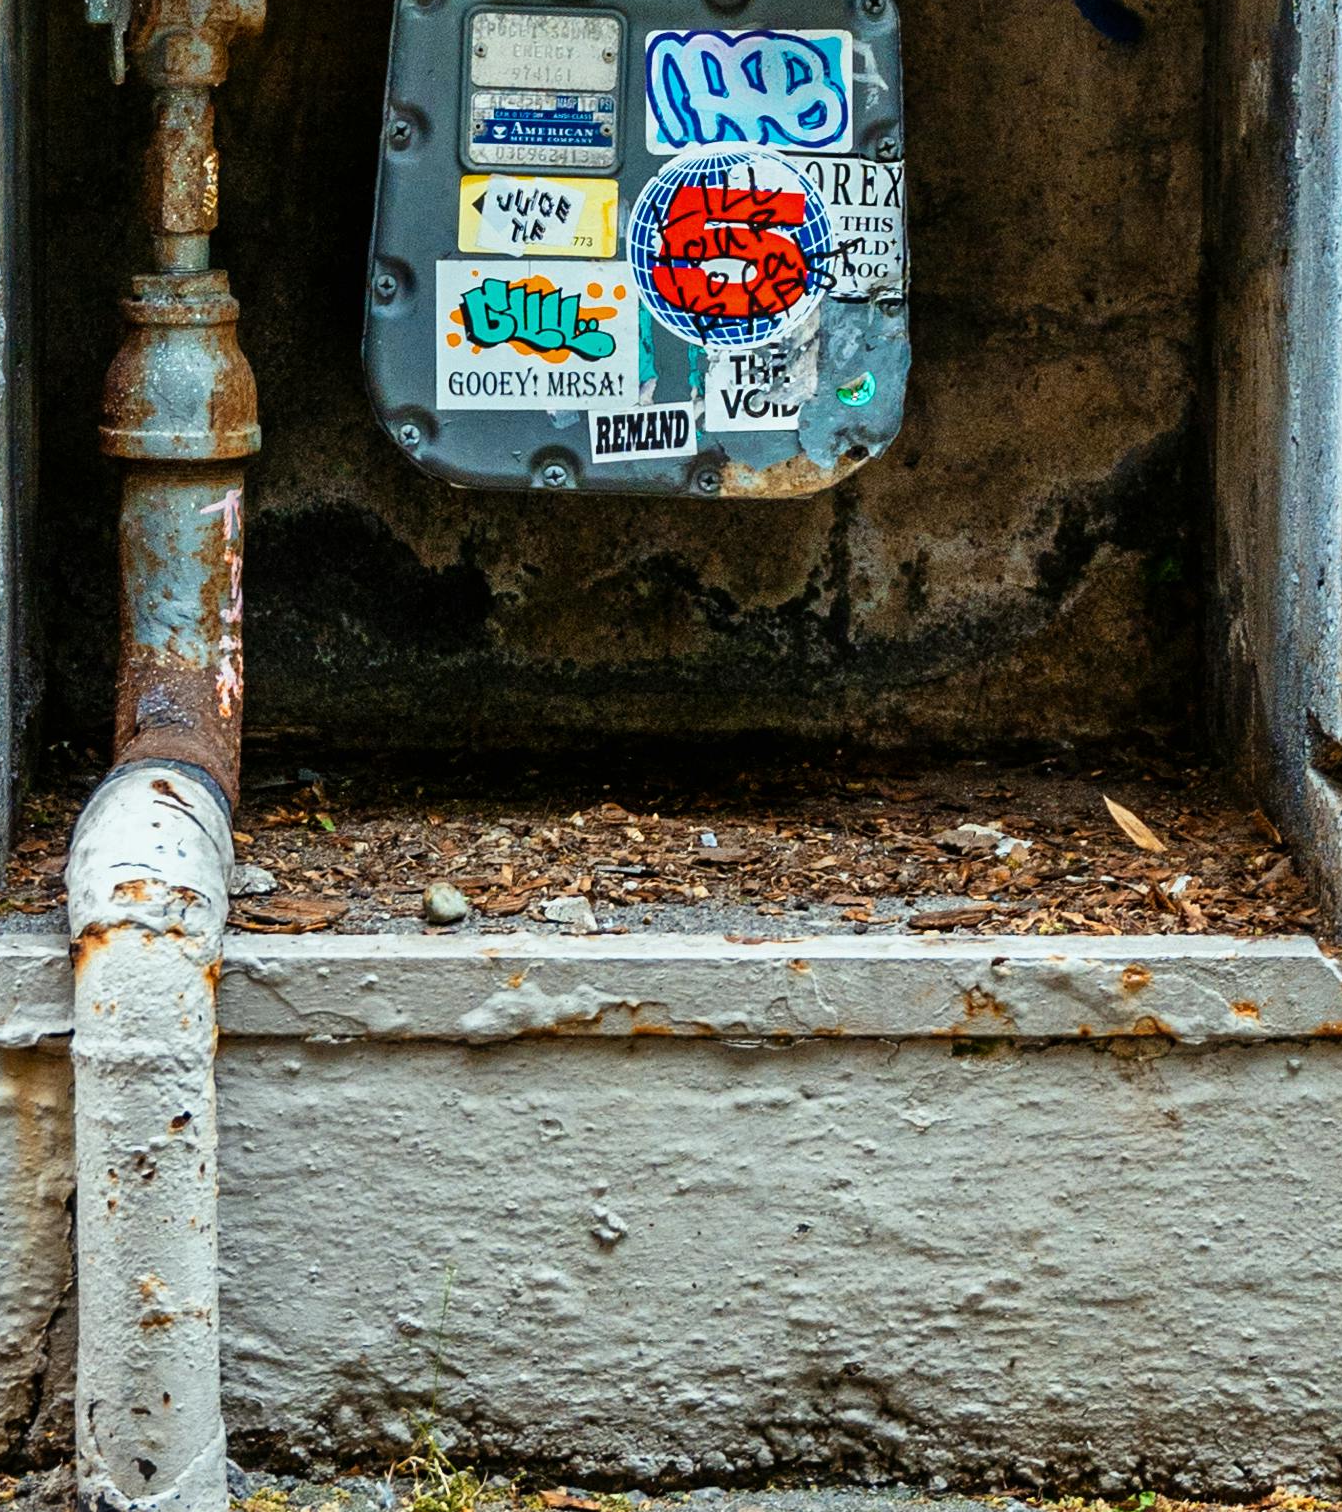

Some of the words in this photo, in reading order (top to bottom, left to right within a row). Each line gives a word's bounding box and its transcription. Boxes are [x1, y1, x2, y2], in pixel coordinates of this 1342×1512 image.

[513, 44, 575, 60] ENERGY
[511, 121, 594, 137] AMERICAN
[840, 215, 894, 233] THIS
[842, 239, 890, 256] OLD
[841, 262, 889, 279] DOG
[448, 367, 538, 396] GOOEY!
[547, 371, 625, 397] MRSA!
[595, 409, 690, 455] REMAND
